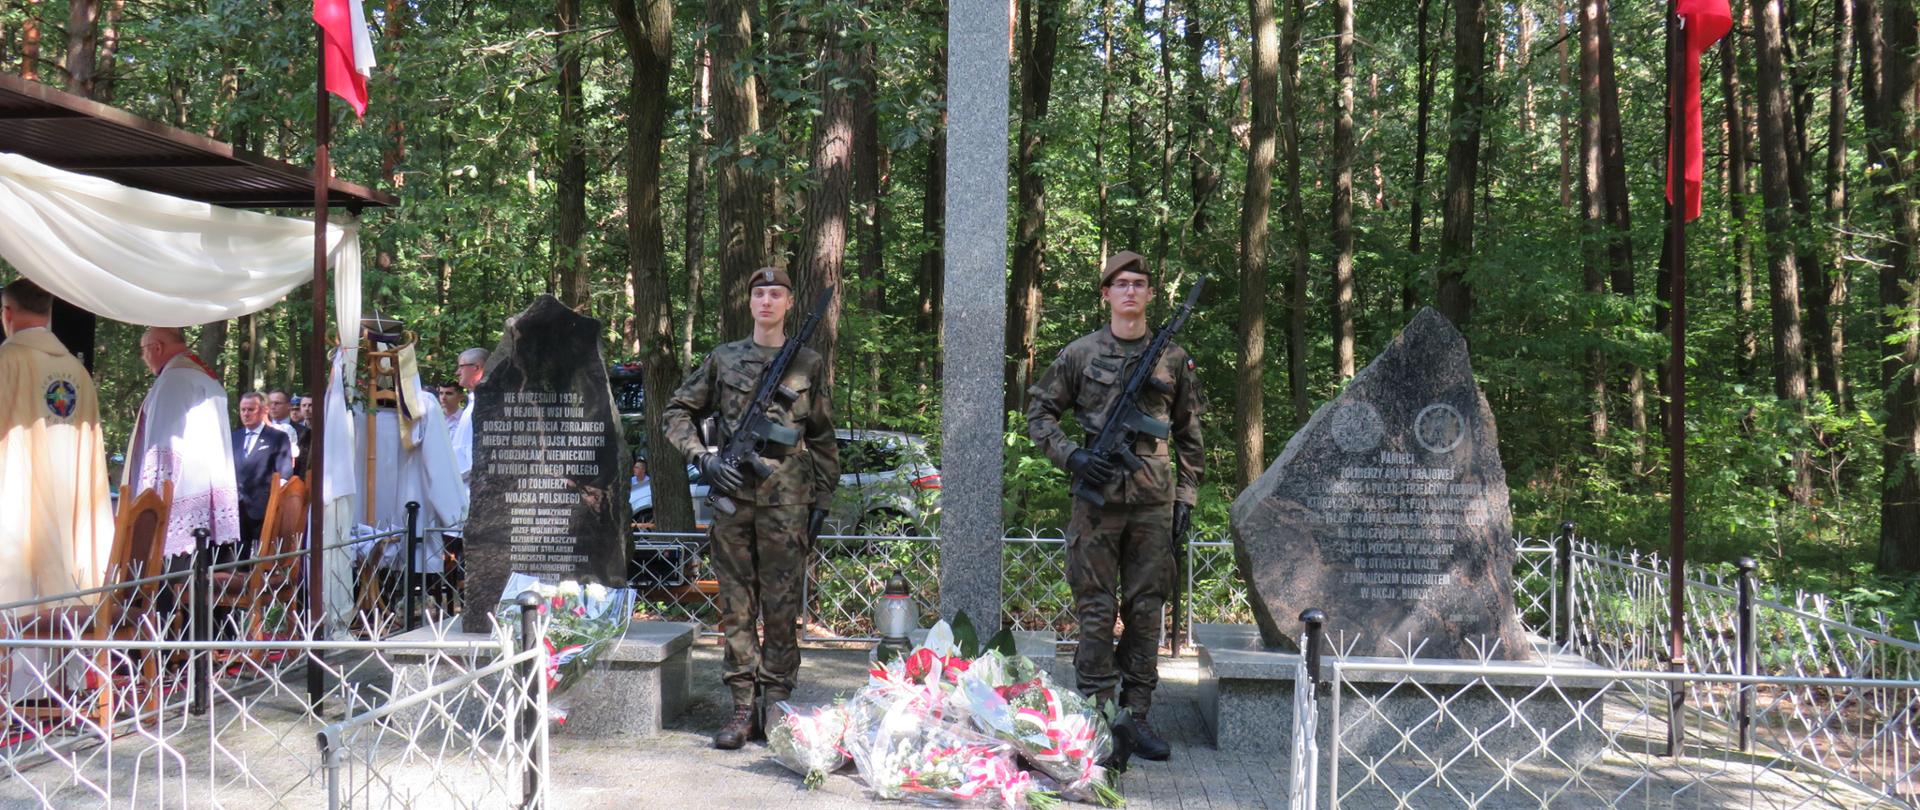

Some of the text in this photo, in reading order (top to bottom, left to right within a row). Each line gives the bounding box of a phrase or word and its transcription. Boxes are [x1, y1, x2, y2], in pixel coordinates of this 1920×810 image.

[504, 393, 515, 402] WE
[504, 407, 584, 417] W REJONIE WSI UNIN
[514, 422, 524, 432] DO
[527, 422, 558, 432] STARCIA
[560, 422, 605, 432] ZBROJNEGO
[540, 436, 566, 446] WOJSK
[568, 436, 605, 447] POLSKICH
[491, 450, 496, 460] A
[547, 450, 595, 461] NIEMIECKIMI
[488, 464, 495, 474] W
[518, 479, 527, 489] 10
[505, 493, 580, 504] WOJSKA POLSKIEGO
[1402, 574, 1450, 585] OKUPANTEM
